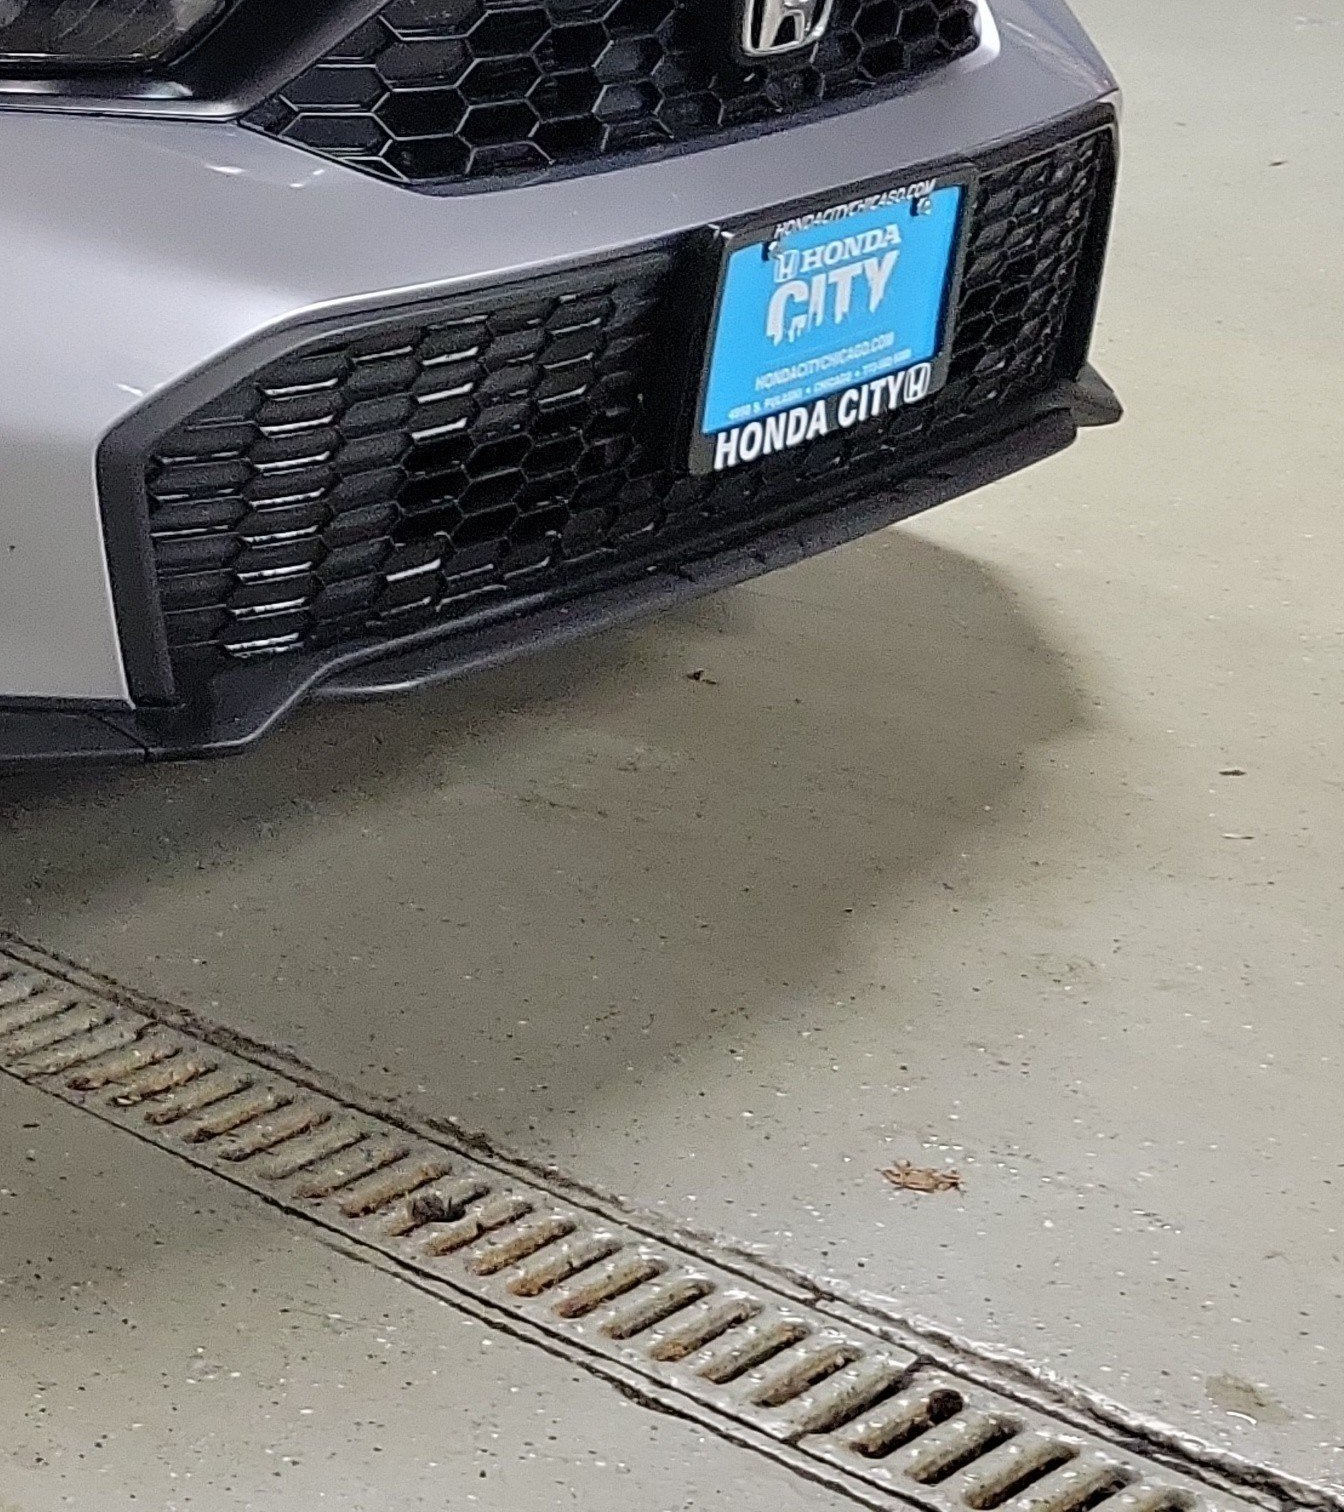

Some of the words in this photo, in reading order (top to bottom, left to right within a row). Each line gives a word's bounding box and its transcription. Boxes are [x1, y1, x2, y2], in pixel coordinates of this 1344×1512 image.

[800, 224, 901, 272] HONDA
[766, 250, 900, 347] CITY
[713, 407, 828, 471] HONDA
[838, 371, 905, 428] CITY
